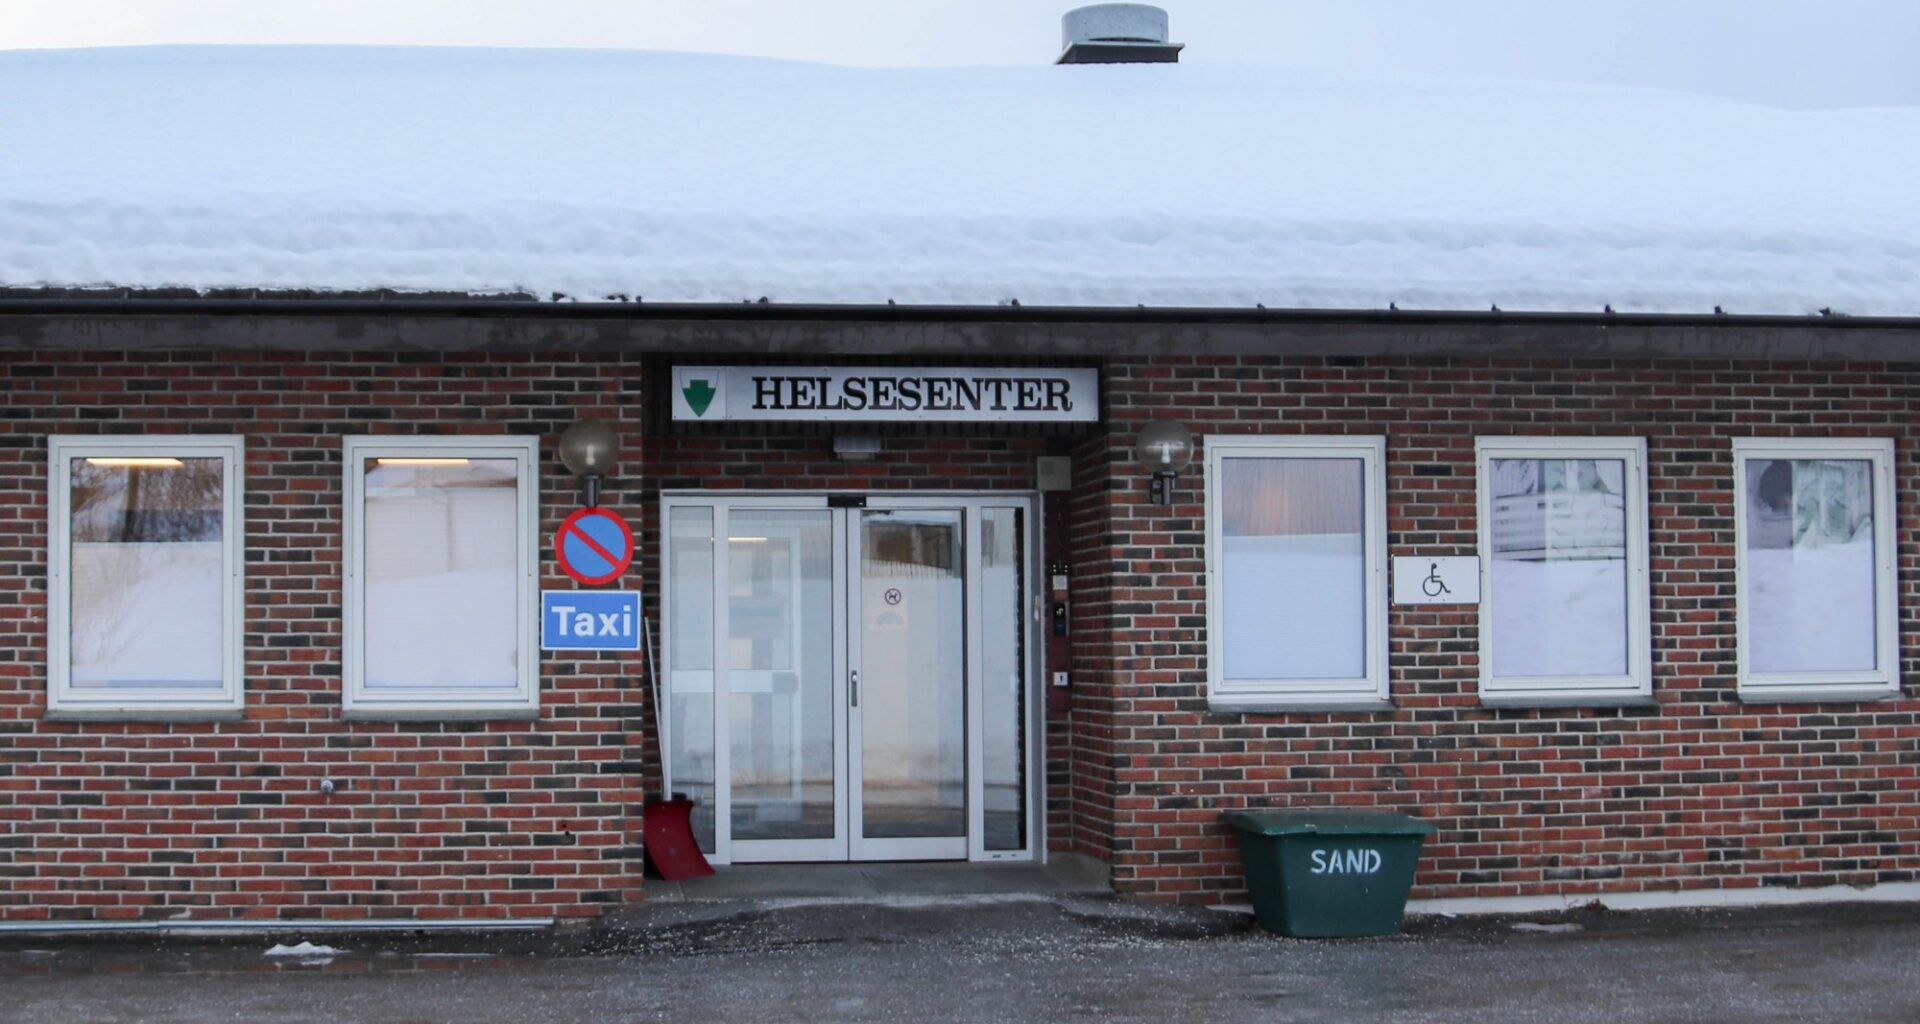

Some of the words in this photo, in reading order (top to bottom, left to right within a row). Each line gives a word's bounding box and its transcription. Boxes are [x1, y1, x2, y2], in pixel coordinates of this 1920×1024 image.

[752, 376, 1073, 412] HELSESENTER
[551, 605, 631, 636] Taxi
[1310, 849, 1382, 874] SAND
